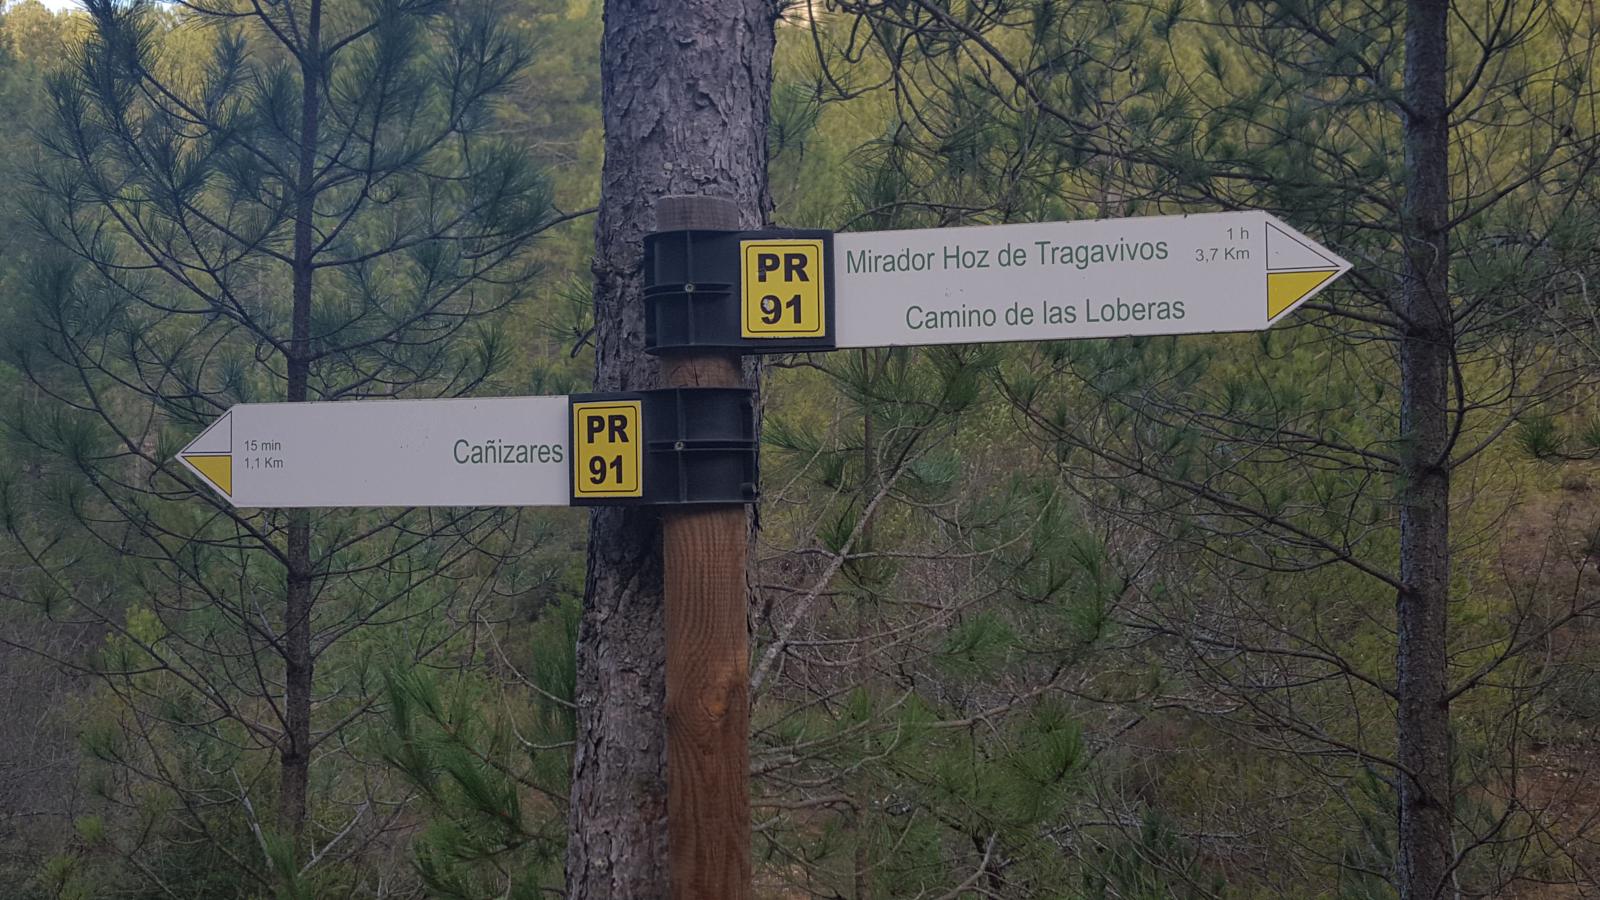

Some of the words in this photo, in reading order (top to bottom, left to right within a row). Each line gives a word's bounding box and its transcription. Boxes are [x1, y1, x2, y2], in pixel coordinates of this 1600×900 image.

[1226, 228, 1232, 241] 1
[1240, 227, 1249, 240] h
[757, 253, 809, 283] PR
[847, 248, 936, 274] Mirador
[944, 246, 989, 270] Hoz
[997, 243, 1027, 268] de
[1035, 238, 1169, 270] Tragavivos
[1195, 248, 1218, 263] 3,7
[1225, 248, 1250, 261] Km
[760, 294, 802, 325] 91
[905, 304, 997, 330] Camino
[1004, 301, 1034, 326] de
[1043, 300, 1077, 325] las
[1085, 298, 1186, 323] Loberas
[587, 414, 629, 444] PR
[244, 440, 257, 452] 15
[261, 440, 282, 452] min
[453, 438, 564, 465] Cañizares
[244, 457, 260, 470] 1,1
[264, 457, 284, 469] Km
[588, 454, 623, 485] 91
